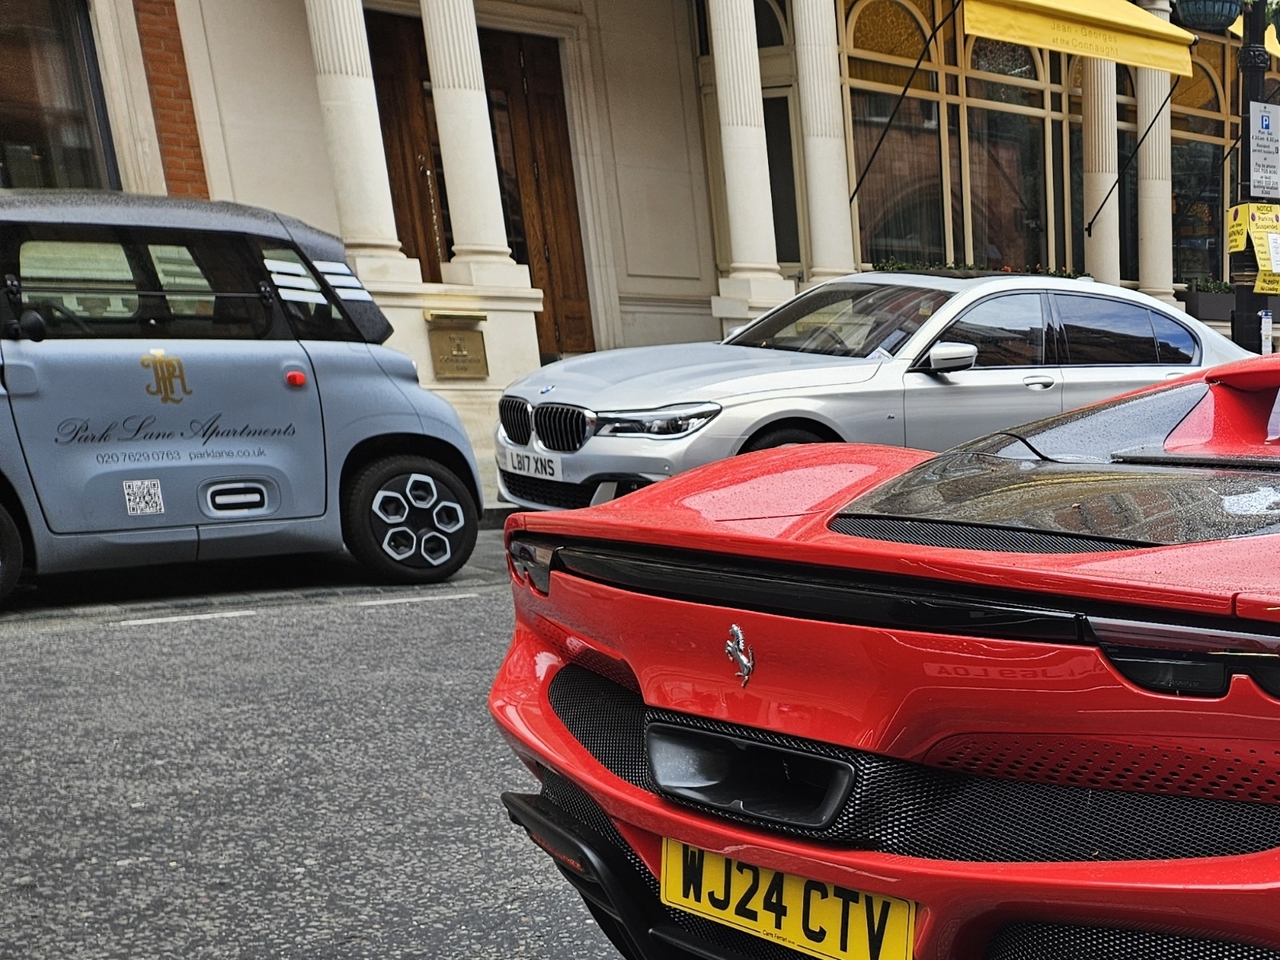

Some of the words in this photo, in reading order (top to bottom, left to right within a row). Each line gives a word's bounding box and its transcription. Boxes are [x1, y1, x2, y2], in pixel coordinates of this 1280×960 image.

[1051, 21, 1072, 33] Jean
[1081, 26, 1118, 43] Georges
[1071, 38, 1119, 56] Connaught
[54, 417, 117, 445] Park
[118, 414, 176, 443] Lane
[181, 412, 296, 446] Apartments
[96, 452, 120, 464] 020
[121, 451, 150, 463] 7629
[152, 450, 181, 462] 0763
[189, 446, 267, 461] parklane.co.uk
[510, 452, 530, 473] LB17
[532, 456, 555, 477] XNS
[682, 843, 788, 931] WJ24
